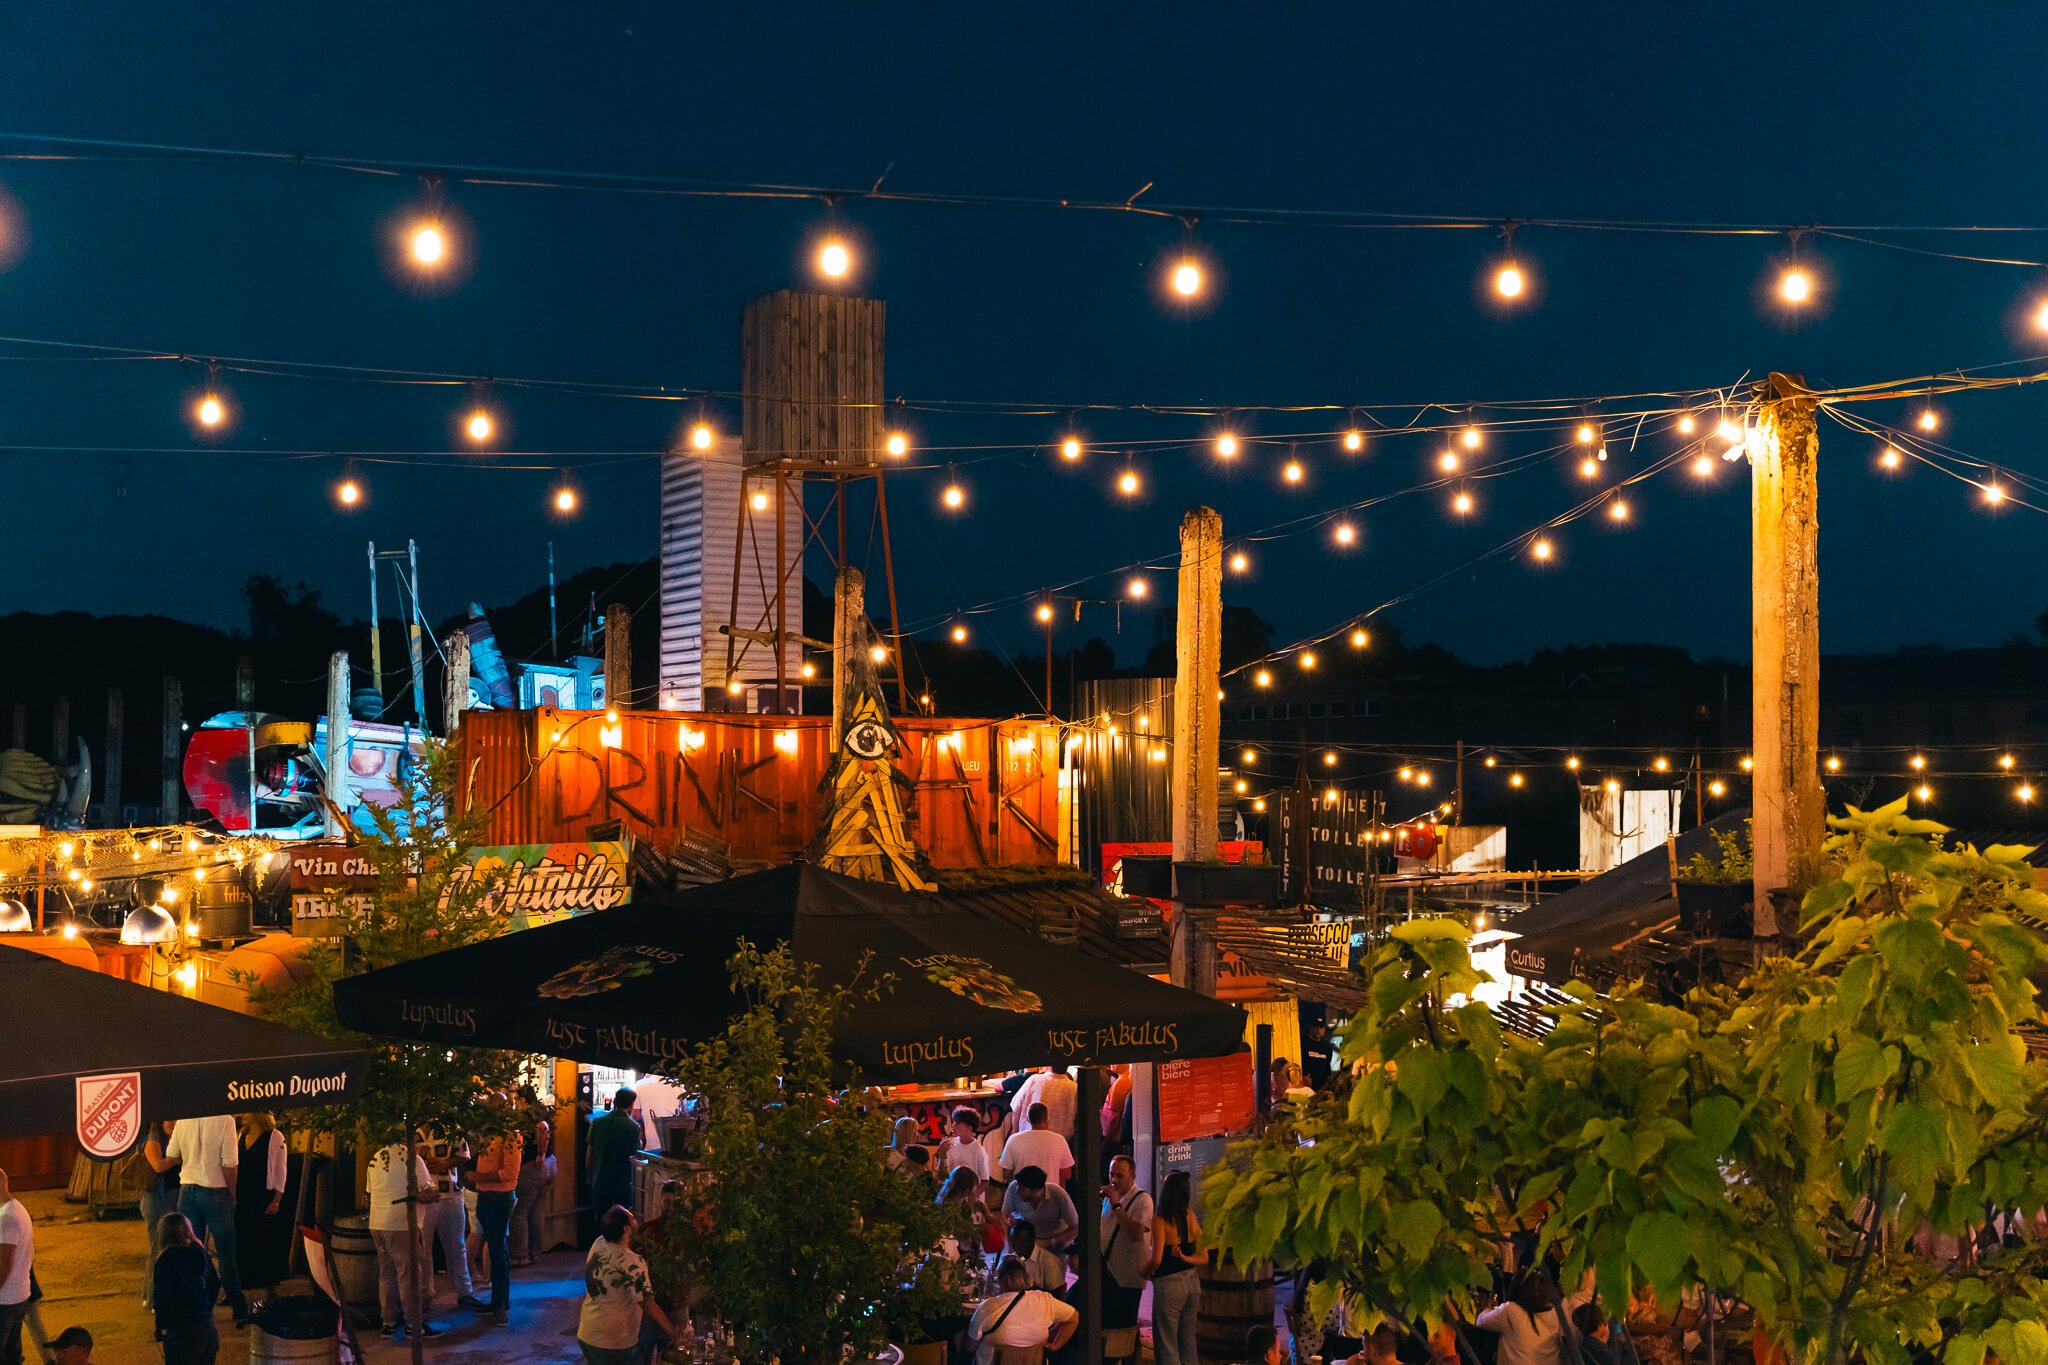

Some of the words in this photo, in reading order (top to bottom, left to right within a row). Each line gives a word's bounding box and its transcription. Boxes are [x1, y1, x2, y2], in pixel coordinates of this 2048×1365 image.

[553, 745, 780, 829] DRINK
[1312, 797, 1386, 815] TOILET
[1312, 827, 1380, 848] TOILET
[293, 857, 338, 876] Vin
[1316, 865, 1375, 886] TOILET
[436, 851, 624, 918] Ccktails
[1510, 949, 1546, 970] Curtius
[1161, 1069, 1191, 1080] bière
[227, 1079, 285, 1101] Saison
[289, 1071, 347, 1098] Dupont
[84, 1081, 114, 1115] BRASSERIE
[84, 1082, 135, 1140] DUPONT
[1167, 1143, 1192, 1154] drink
[1167, 1152, 1192, 1162] drink
